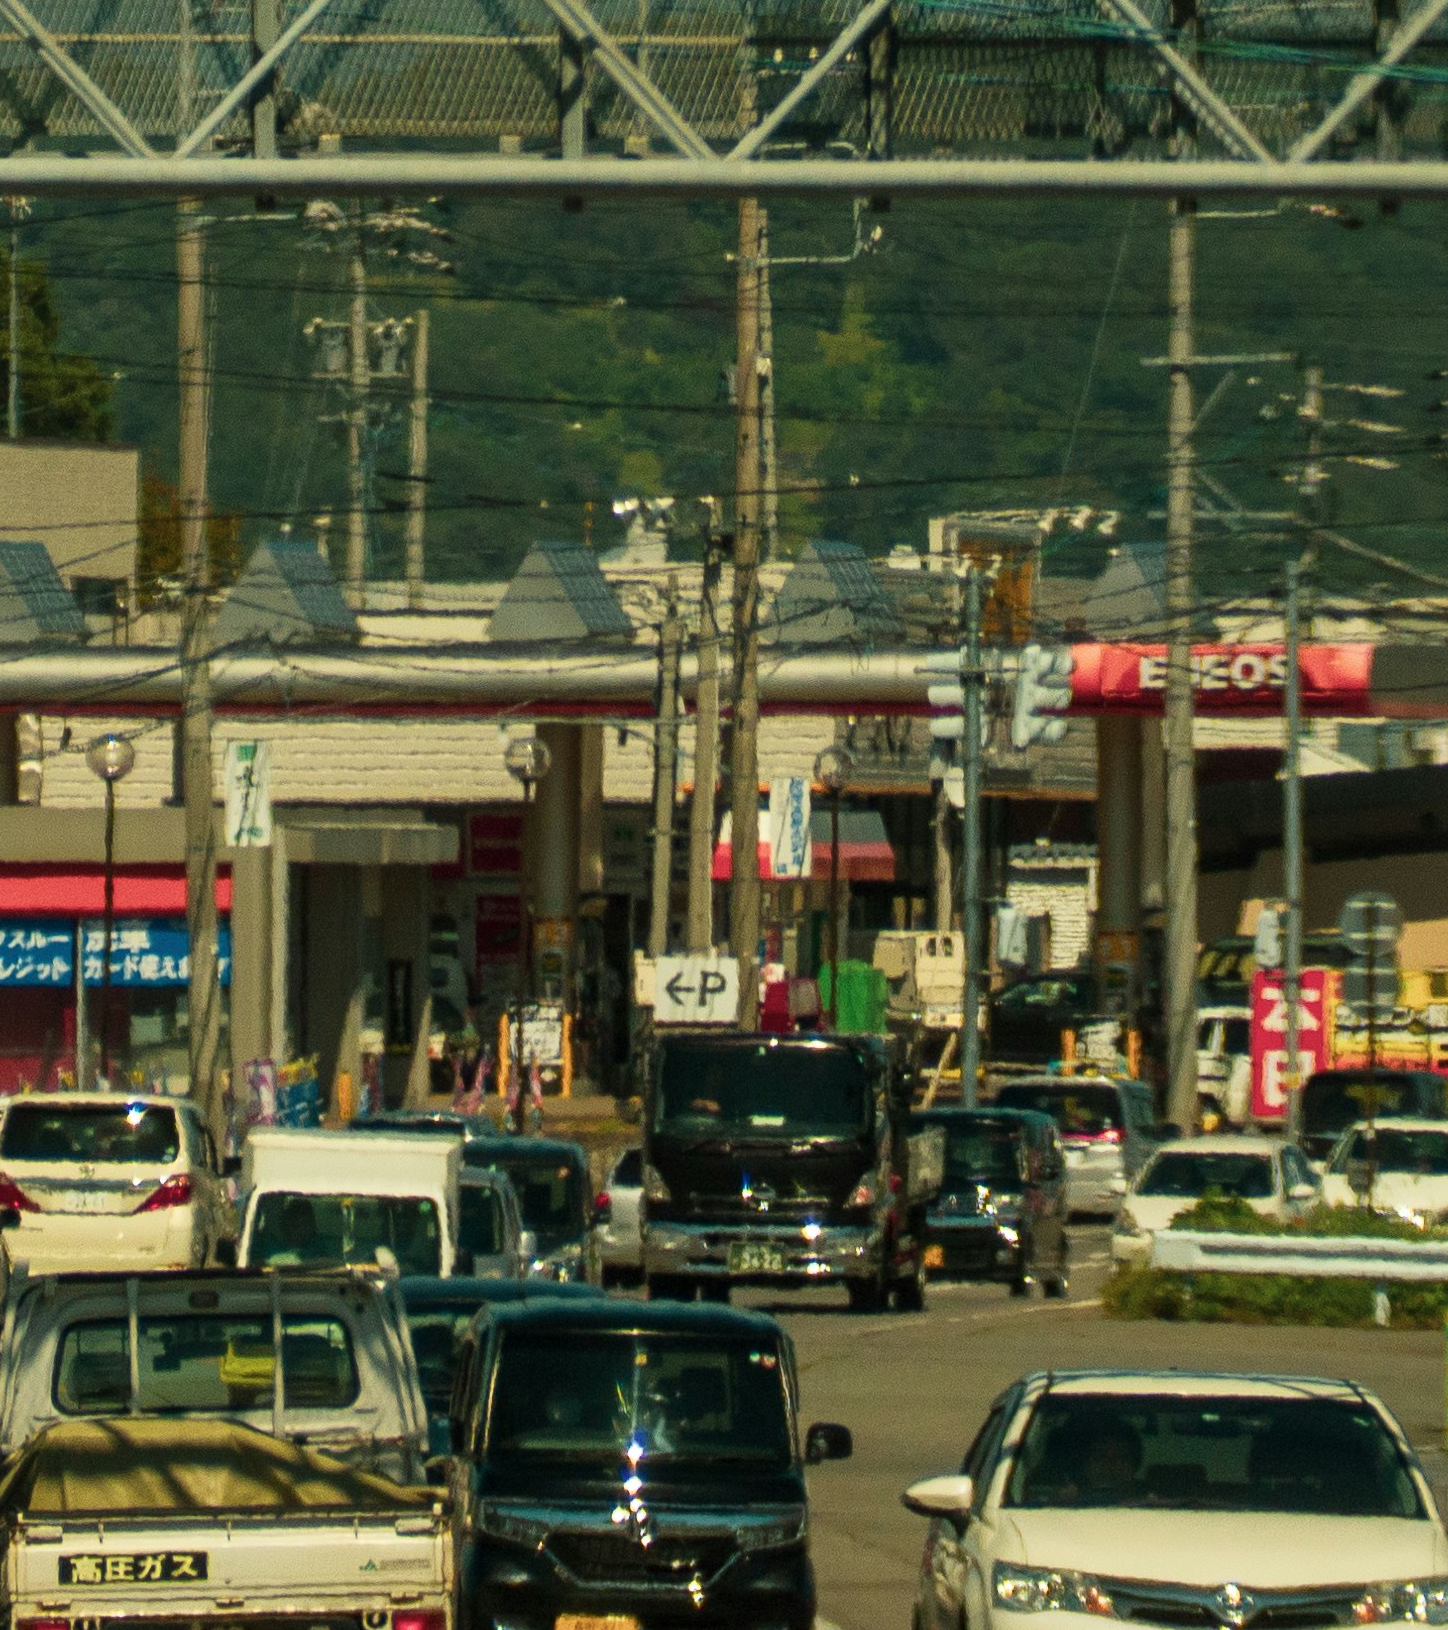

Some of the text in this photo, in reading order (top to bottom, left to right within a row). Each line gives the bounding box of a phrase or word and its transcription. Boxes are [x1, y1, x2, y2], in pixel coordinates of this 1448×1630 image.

[698, 970, 727, 996] P
[70, 1554, 200, 1584] 高圧ガス
